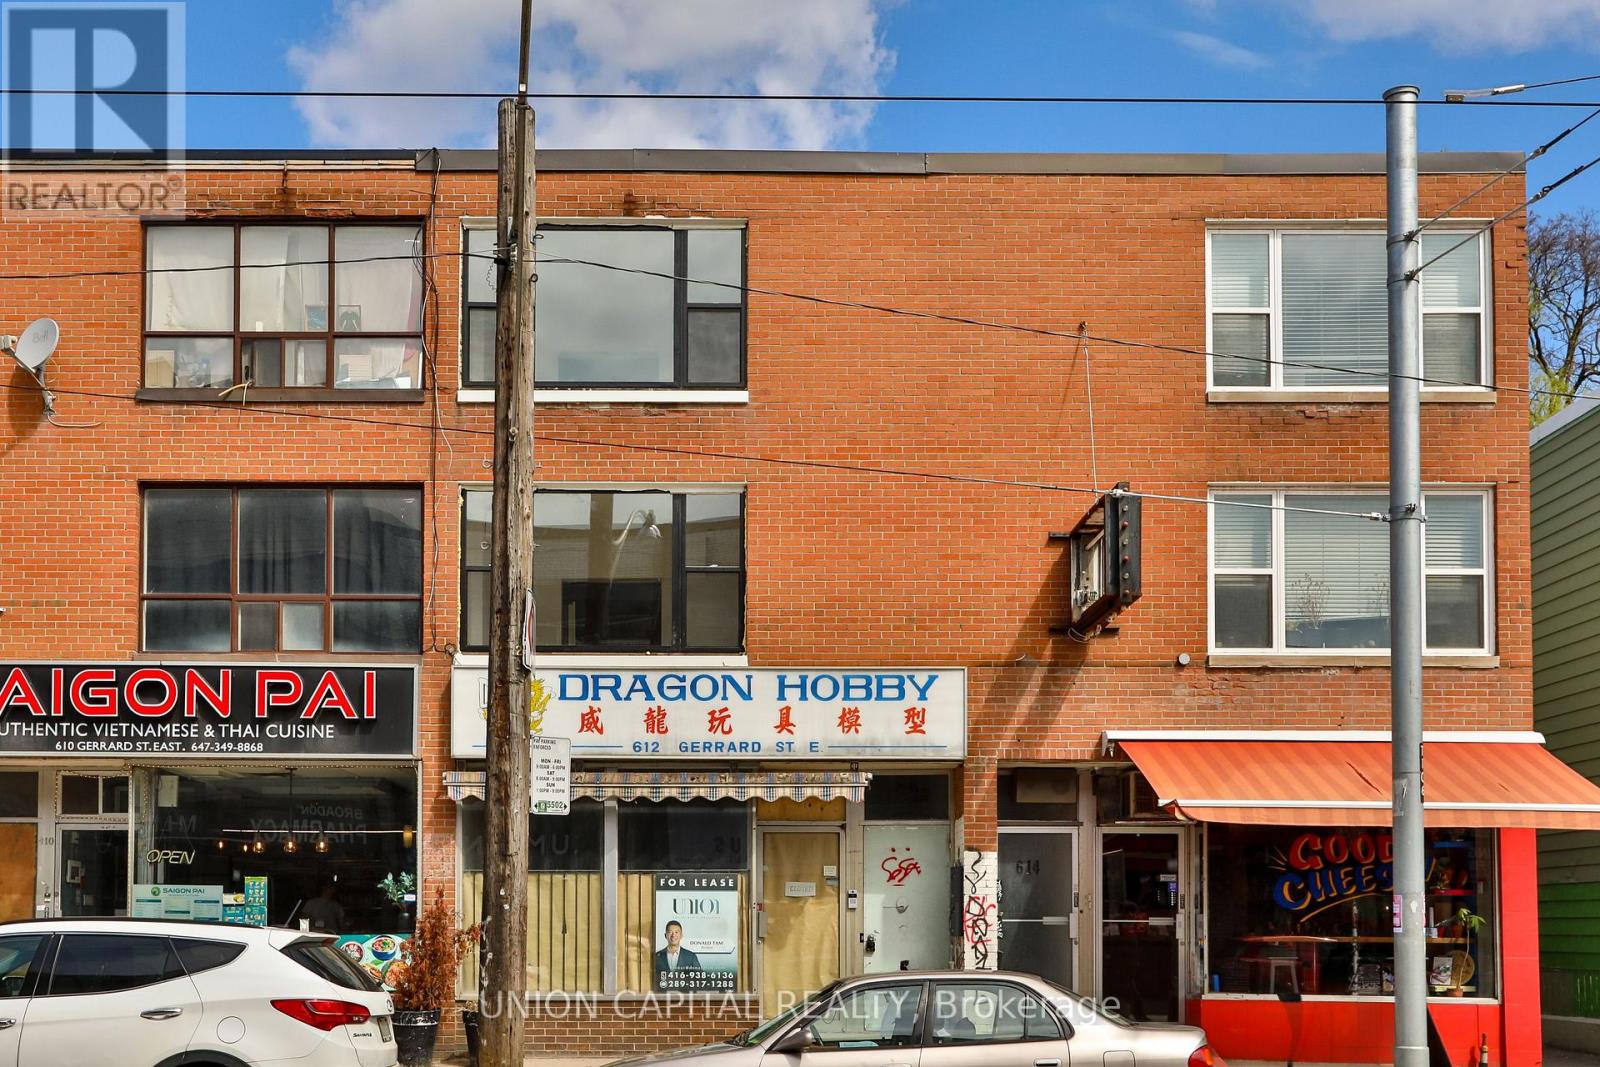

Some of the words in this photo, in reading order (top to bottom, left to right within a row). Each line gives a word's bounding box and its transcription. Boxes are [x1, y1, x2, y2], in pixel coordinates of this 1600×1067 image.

[255, 670, 376, 719] PAI
[558, 674, 753, 701] DRAGON
[776, 674, 939, 701] HOBBY
[578, 705, 927, 735] 威龍玩具模型
[93, 722, 199, 738] VIETNAMESE
[204, 724, 215, 738] &
[218, 724, 259, 738] THAI
[265, 724, 334, 739] CUISINE
[55, 741, 74, 751] 610
[77, 741, 133, 751] GERRARD
[191, 742, 264, 752] 647-349-8868
[632, 741, 660, 753] 612
[679, 741, 761, 753] GERRARD
[146, 849, 196, 864] OPEN
[1015, 860, 1040, 875] 614
[660, 878, 686, 887] FOR
[694, 878, 734, 887] LEASE
[1273, 864, 1394, 911] CHEES
[668, 971, 734, 979] 416-938-6136
[668, 980, 734, 988] 289-317-1288
